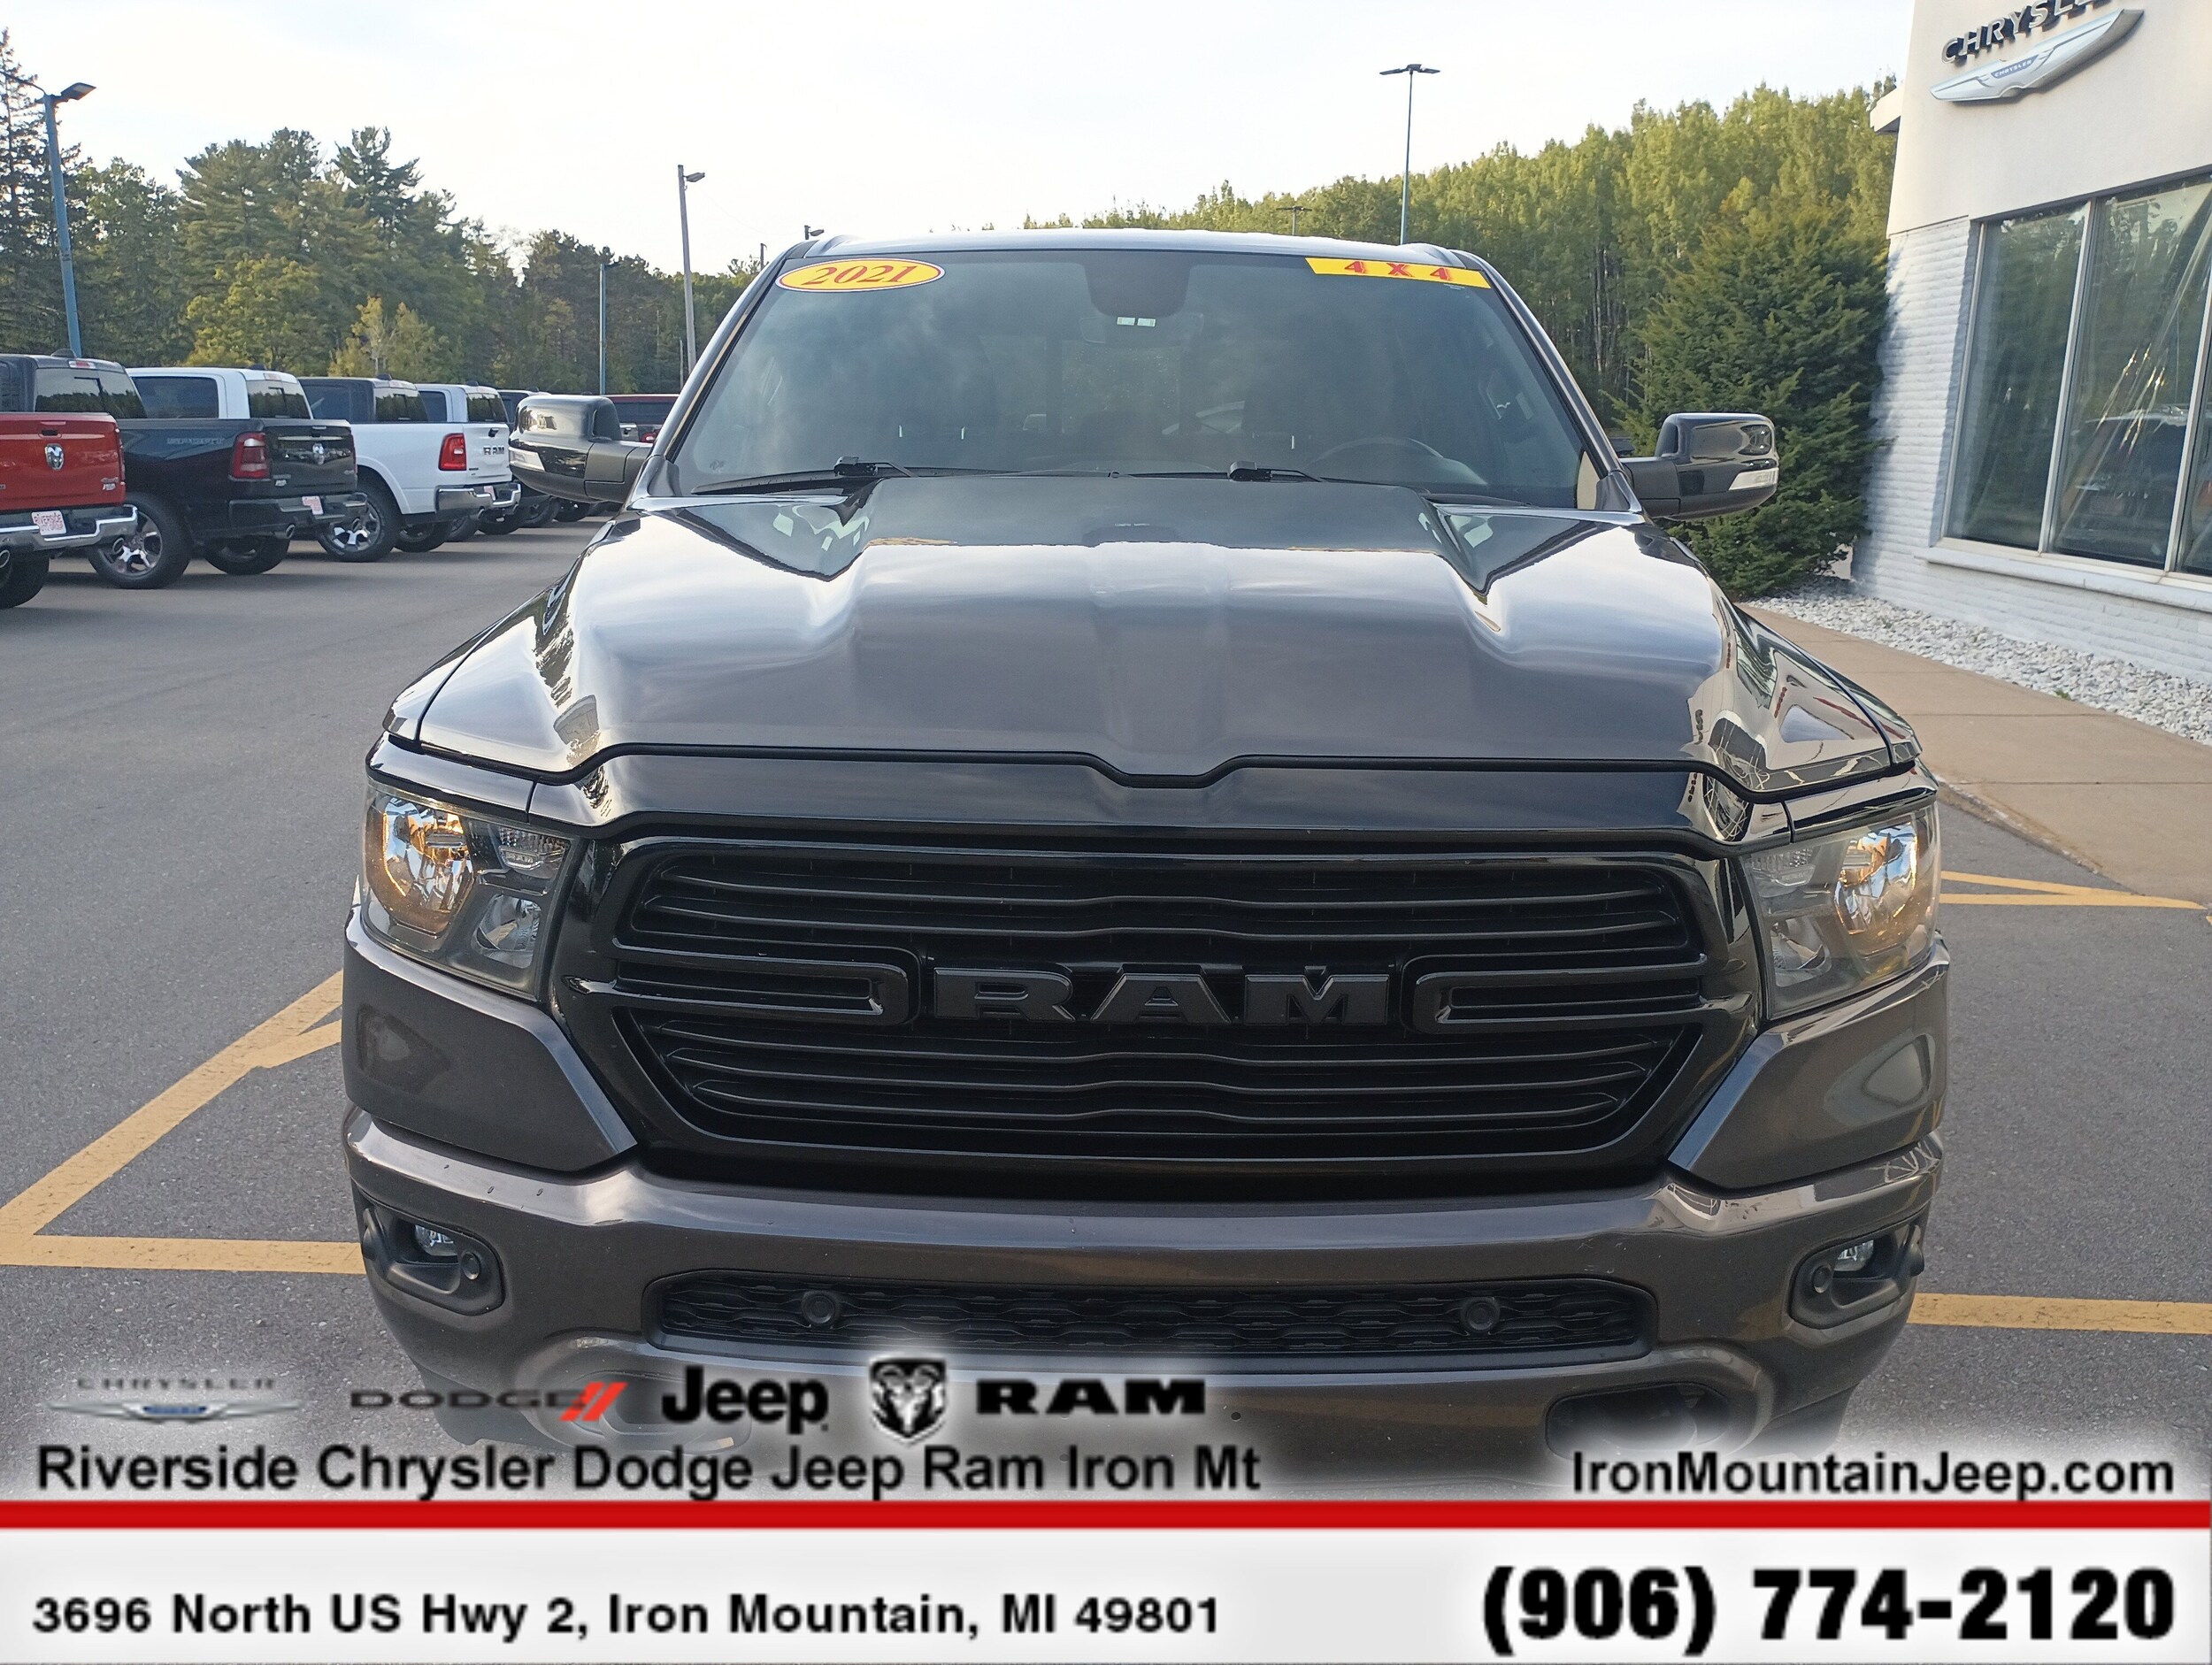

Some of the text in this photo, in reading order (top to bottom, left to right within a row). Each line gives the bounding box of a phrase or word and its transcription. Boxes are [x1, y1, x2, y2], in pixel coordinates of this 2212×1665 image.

[1940, 0, 2093, 65] CHRYSL
[1993, 59, 2032, 78] CHRYSLER
[801, 265, 918, 287] 2021
[1344, 260, 1366, 274] 4
[1429, 267, 1453, 281] 4
[933, 966, 1390, 1024] RAM
